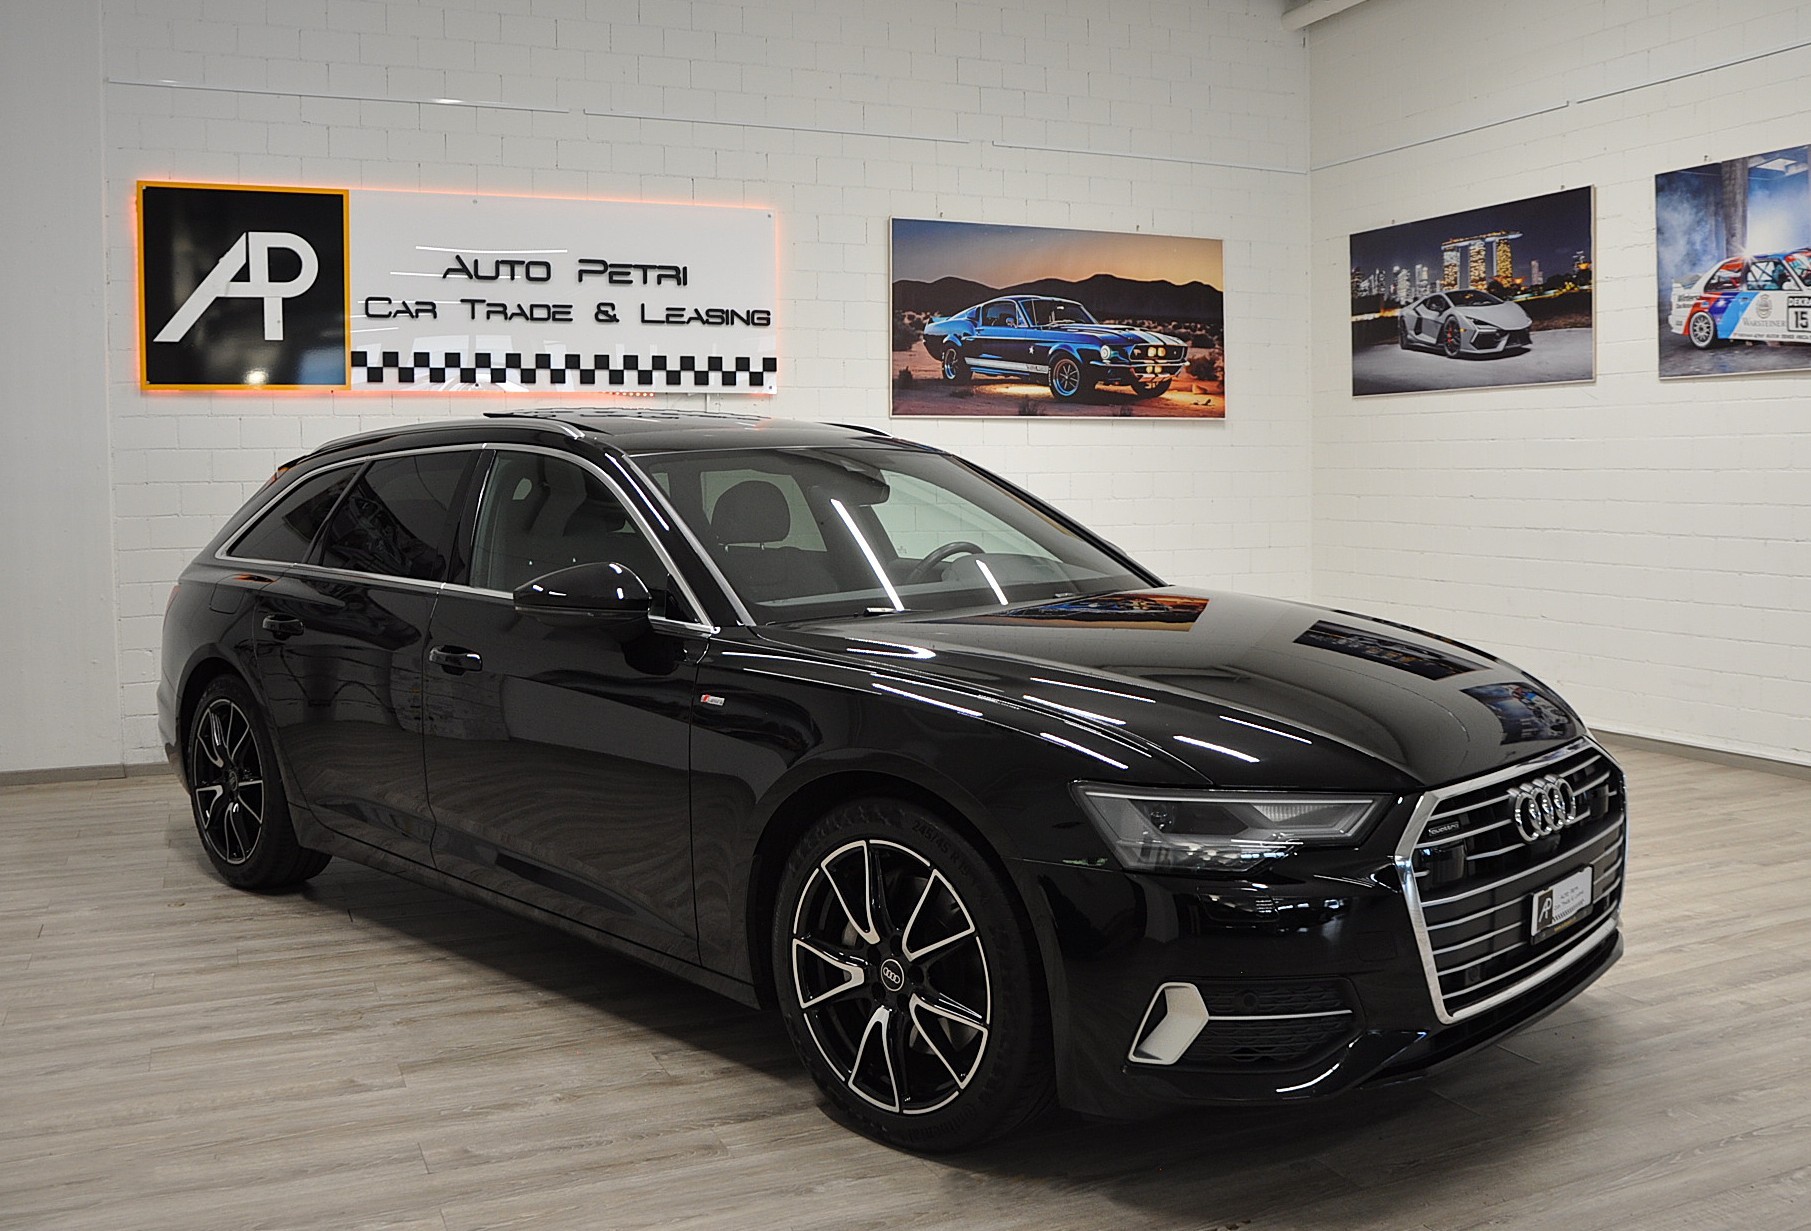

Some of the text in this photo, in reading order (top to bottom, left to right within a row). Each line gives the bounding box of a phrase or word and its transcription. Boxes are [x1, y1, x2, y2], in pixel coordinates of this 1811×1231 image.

[442, 254, 688, 286] AUTO PETRI
[153, 231, 319, 342] AP
[364, 296, 771, 327] CAR TRADE & LEASING
[1794, 311, 1809, 328] 15
